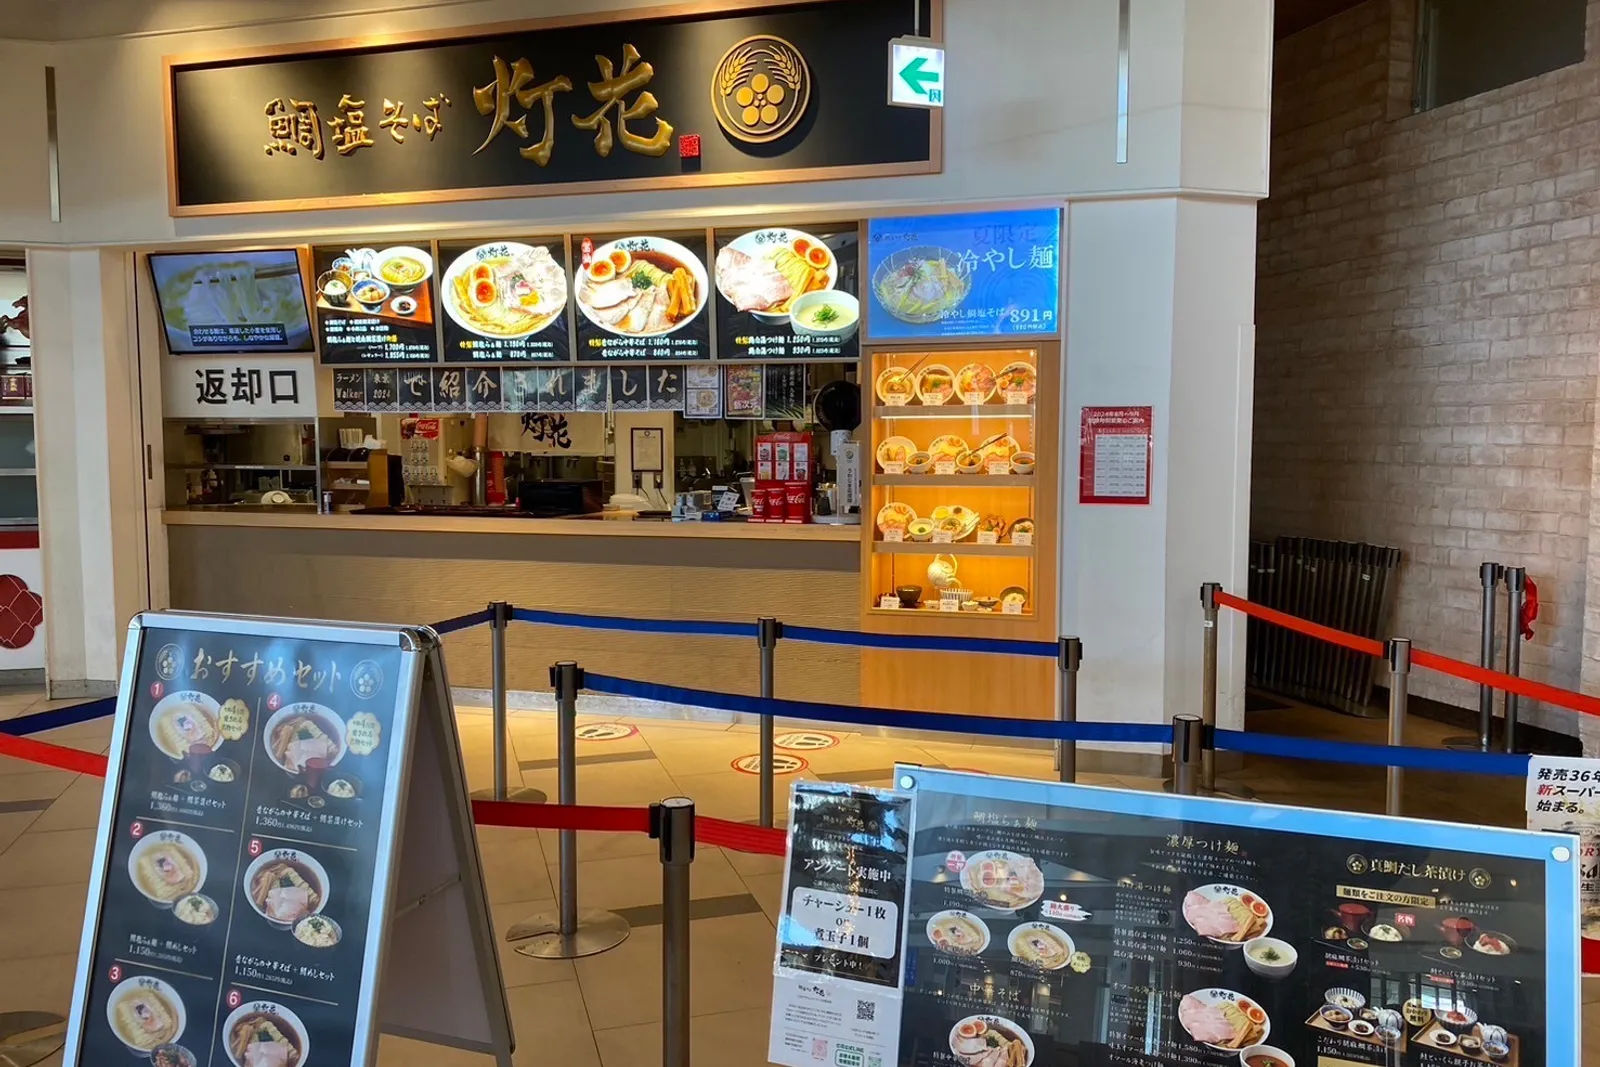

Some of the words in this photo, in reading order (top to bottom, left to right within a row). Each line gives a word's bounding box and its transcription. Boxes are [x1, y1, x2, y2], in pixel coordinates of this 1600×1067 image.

[263, 93, 452, 160] 鯛塩そば
[472, 43, 674, 167] 灯花
[973, 222, 1038, 246] 夏限定
[957, 244, 1054, 273] 冷やし麺
[1010, 309, 1053, 323] 891円
[195, 367, 300, 405] 返却口
[336, 373, 362, 384] ラーメン
[336, 388, 363, 399] Walker
[373, 389, 391, 399] 2024
[190, 647, 342, 693] おすすめセット
[1537, 768, 1600, 783] 発売36年
[1536, 799, 1584, 814] 始まる。
[973, 811, 1038, 831] 鯛塩らぁ麺
[1165, 833, 1240, 855] 濃厚つけ麺
[804, 857, 892, 883] アンケート実施中
[1371, 858, 1466, 882] 真鯛だし茶漬け
[803, 895, 886, 920] チャーシュー1枚
[1343, 887, 1430, 907] 麺類をご注文の方限定
[1397, 914, 1414, 925] 名物
[814, 927, 870, 949] 煮玉子1個
